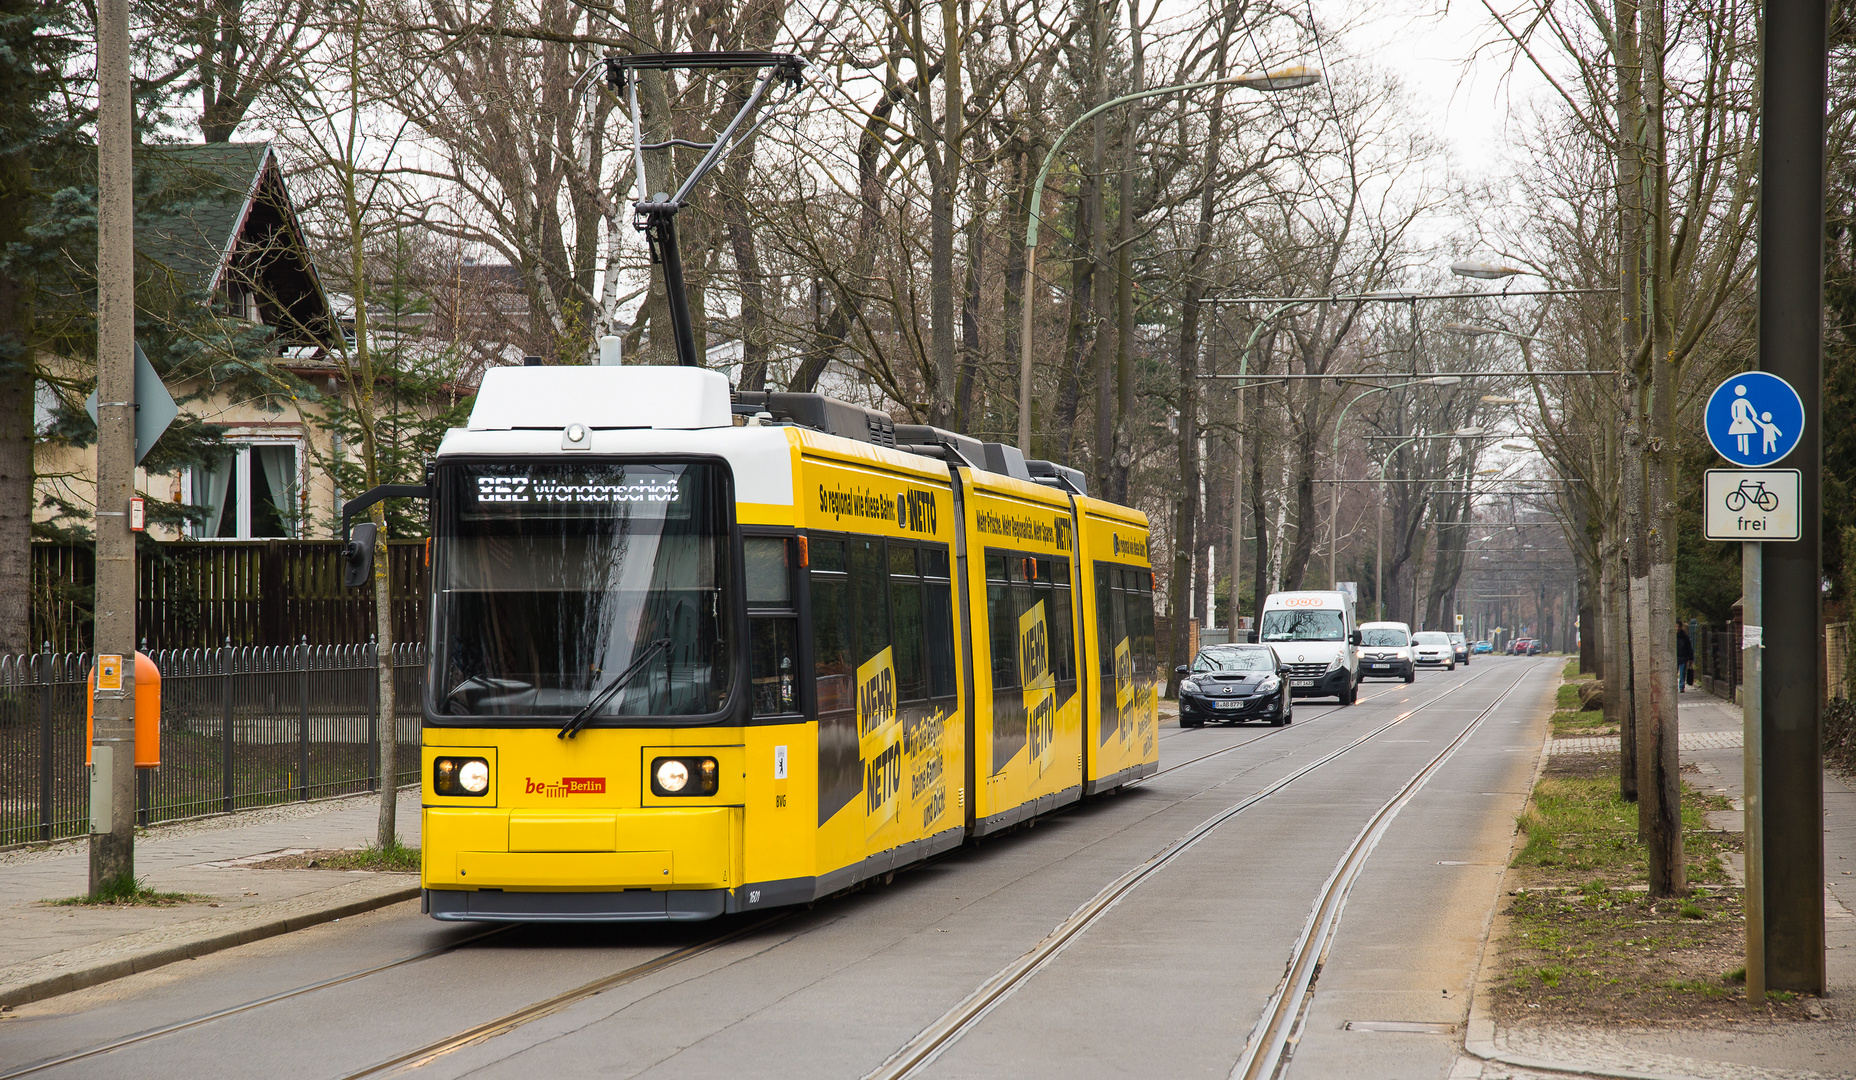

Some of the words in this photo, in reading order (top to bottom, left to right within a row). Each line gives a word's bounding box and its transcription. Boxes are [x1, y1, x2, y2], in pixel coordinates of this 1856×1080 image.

[819, 484, 828, 512] So
[828, 482, 853, 521] regional
[853, 485, 864, 517] wie
[865, 487, 880, 519] diese
[909, 487, 937, 536] NETTO
[1738, 516, 1766, 531] frei
[1055, 516, 1072, 552] NETTO
[1022, 619, 1047, 687] MEHR
[1117, 649, 1131, 694] MEHR
[860, 666, 893, 739] MEHR
[1119, 697, 1133, 745] NETTO
[1029, 692, 1054, 765] NETTO
[525, 777, 546, 794] be
[569, 781, 602, 792] Berlin
[776, 794, 787, 808] BVG
[867, 740, 900, 817] NETTO
